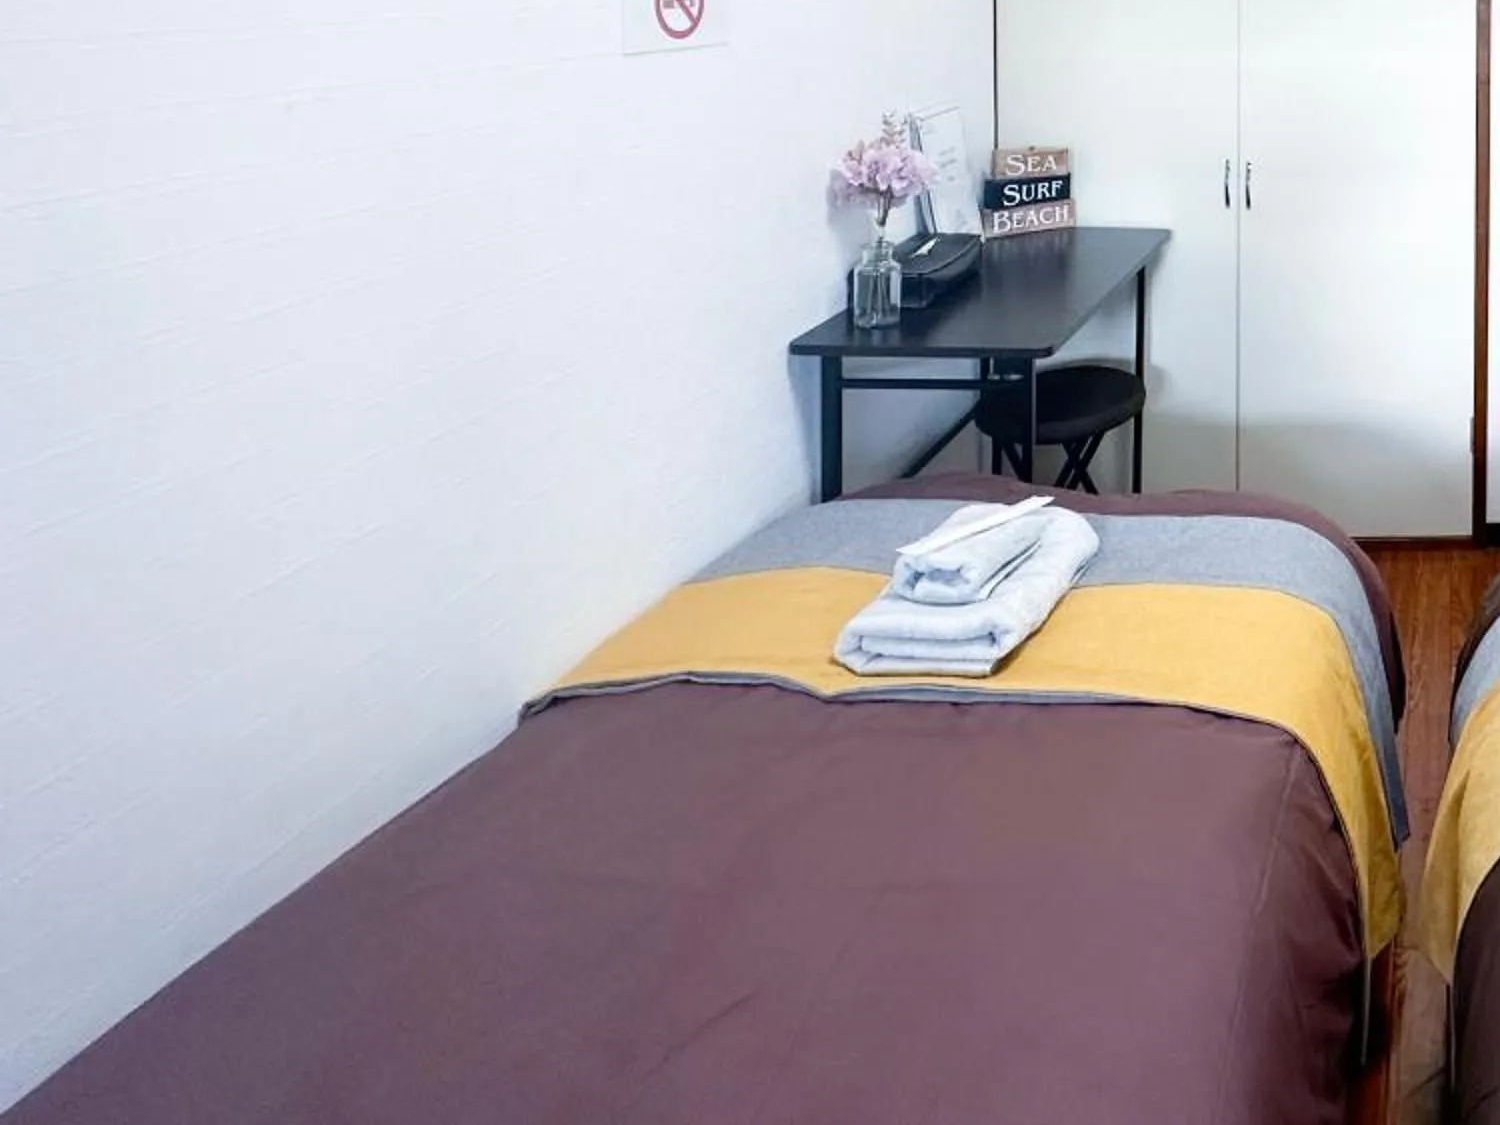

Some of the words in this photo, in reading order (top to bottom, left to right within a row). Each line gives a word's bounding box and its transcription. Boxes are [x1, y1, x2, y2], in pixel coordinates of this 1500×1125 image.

[1006, 154, 1057, 176] SEA
[1003, 180, 1063, 206] SURF
[993, 205, 1069, 234] BEACH
